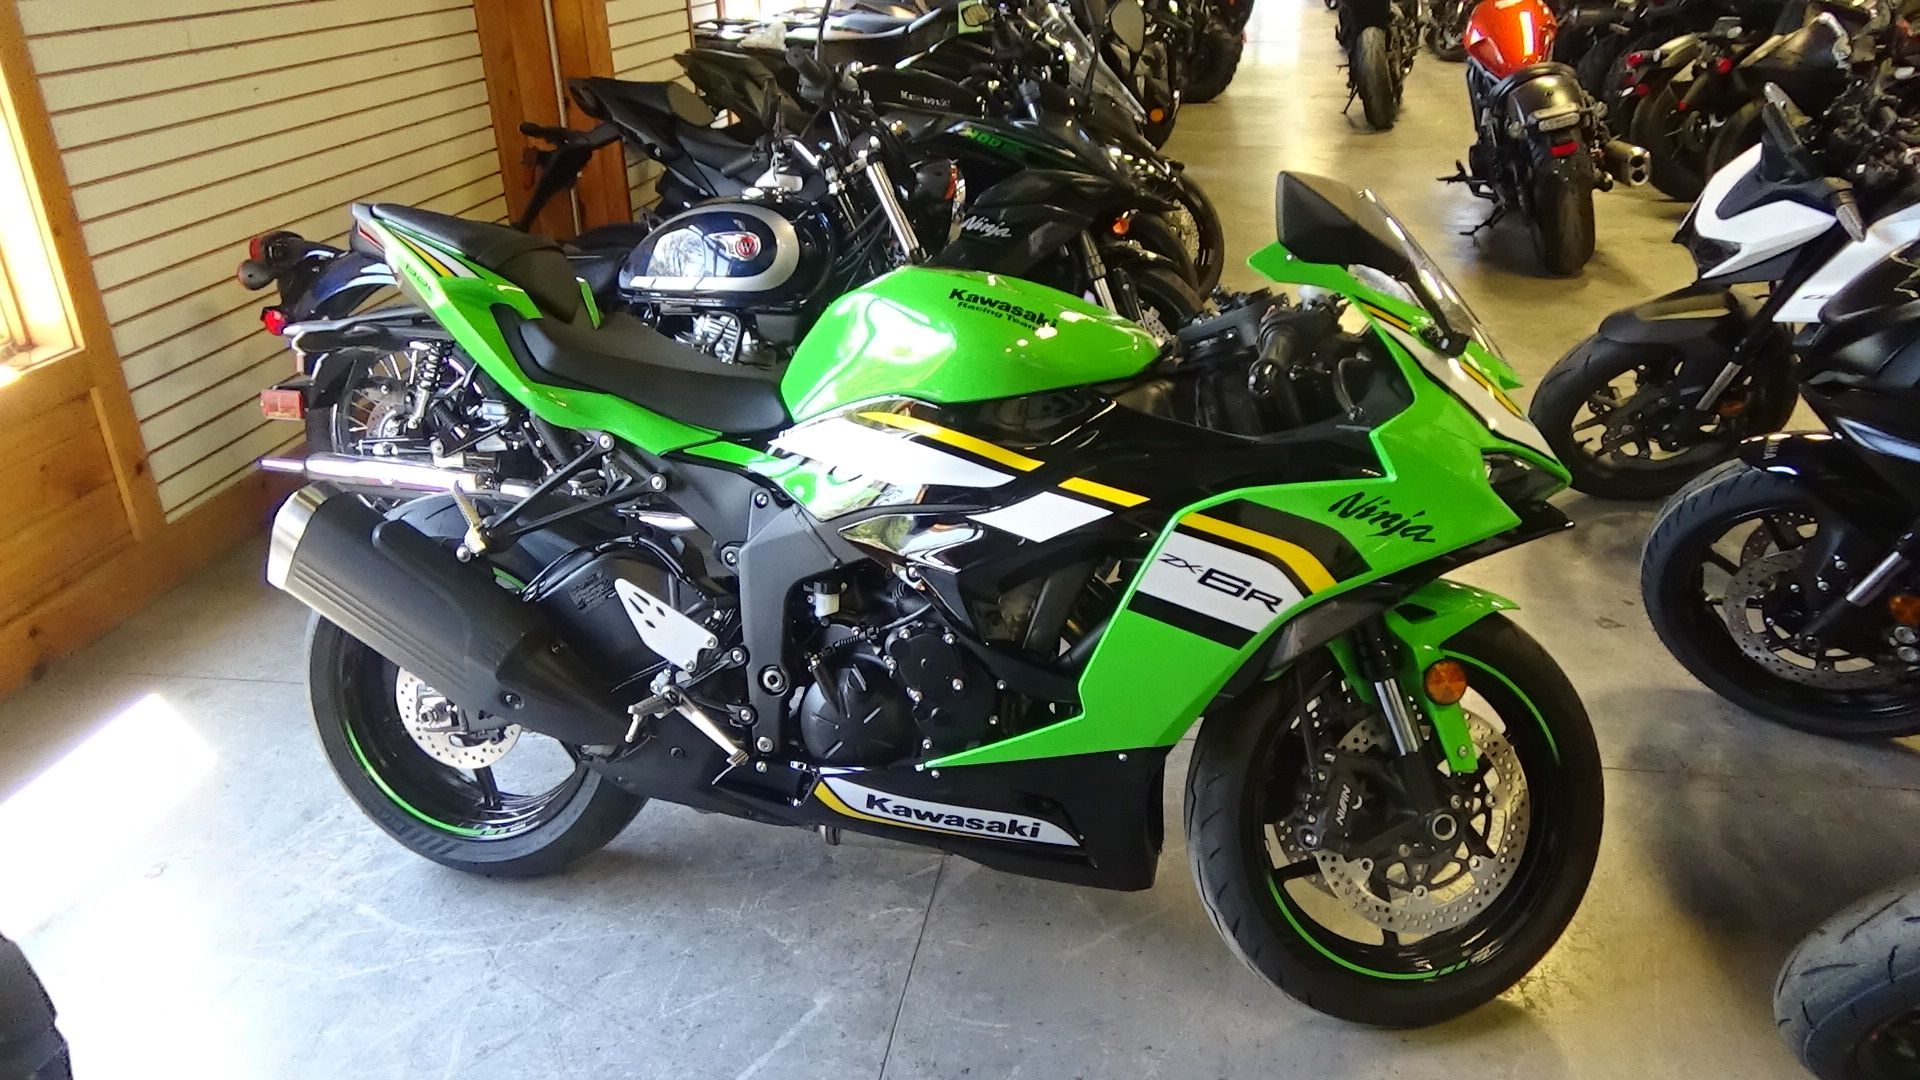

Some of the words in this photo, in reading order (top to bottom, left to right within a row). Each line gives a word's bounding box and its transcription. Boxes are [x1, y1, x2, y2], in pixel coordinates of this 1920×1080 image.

[961, 215, 1012, 237] Ninja
[948, 288, 1059, 329] Kawasaki
[957, 301, 1004, 319] Racing
[1327, 491, 1436, 543] Ninja
[865, 793, 1042, 839] Kawasaki
